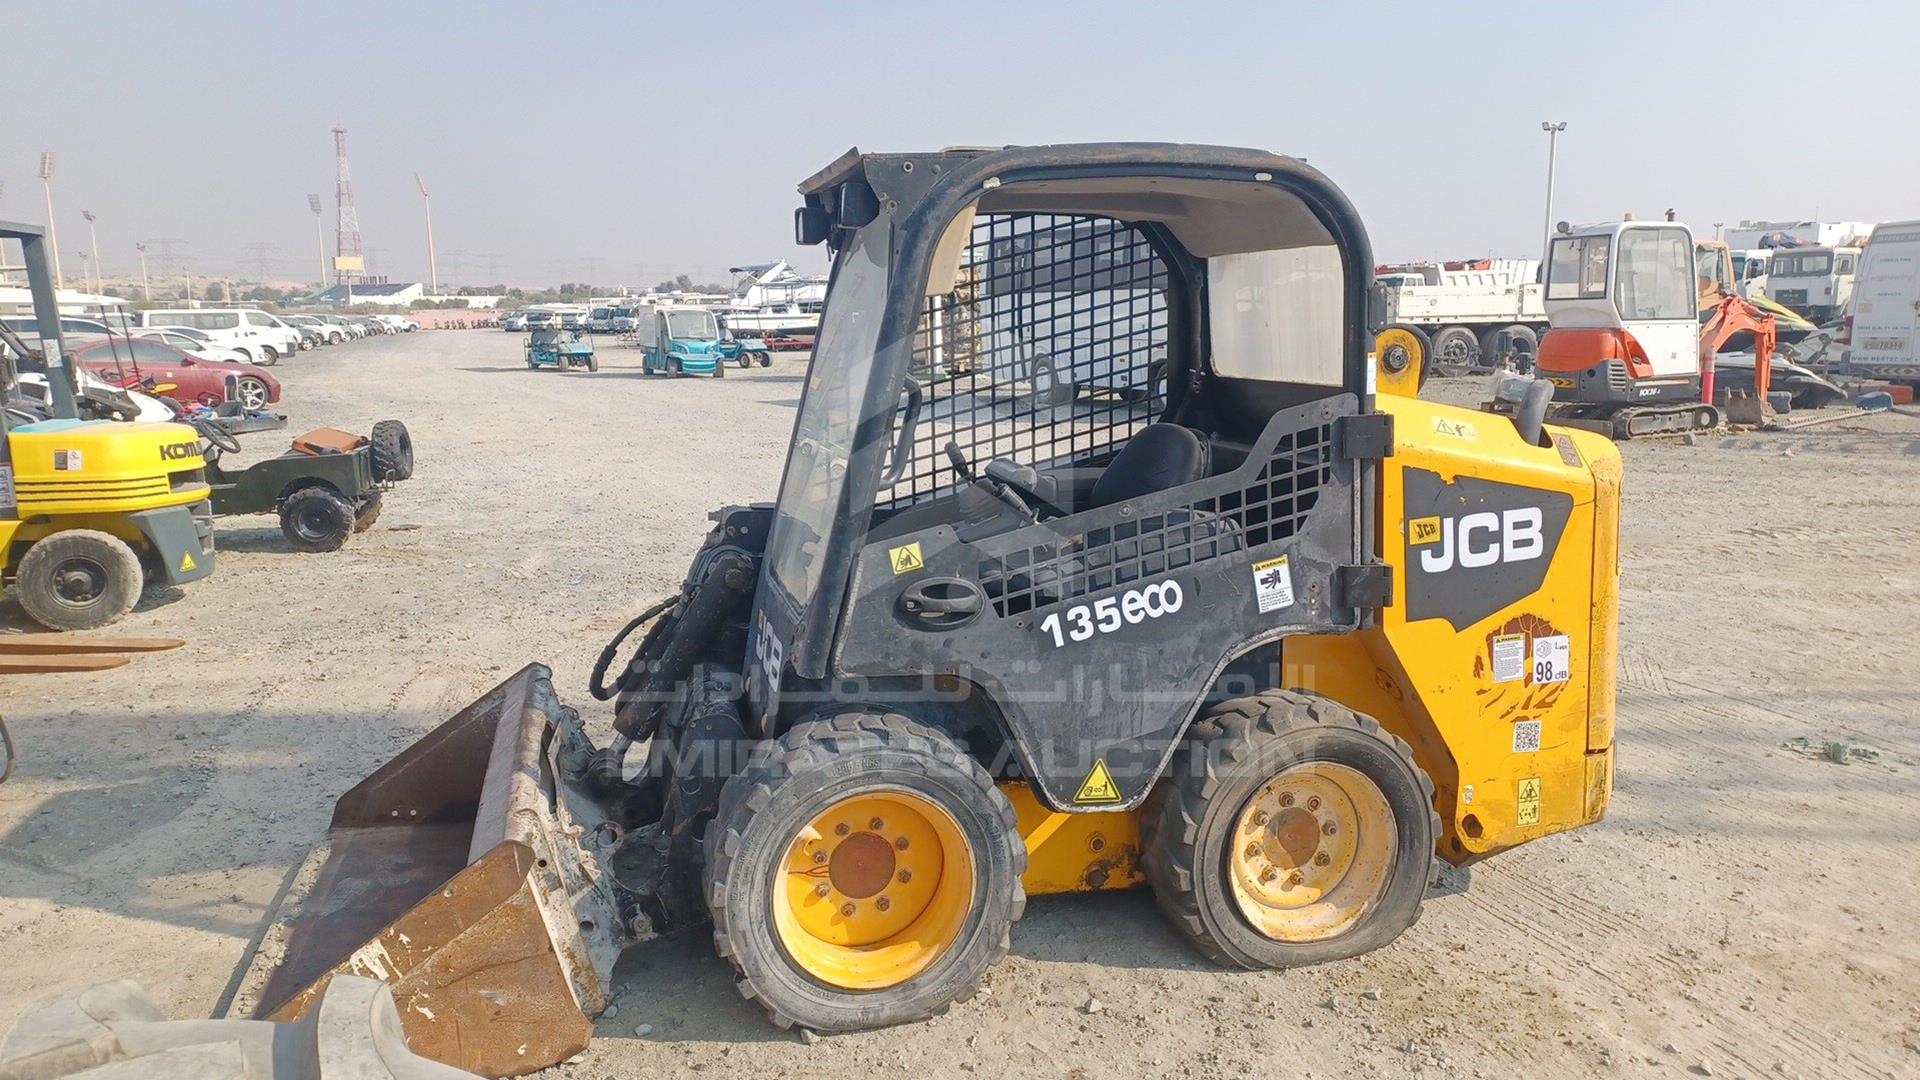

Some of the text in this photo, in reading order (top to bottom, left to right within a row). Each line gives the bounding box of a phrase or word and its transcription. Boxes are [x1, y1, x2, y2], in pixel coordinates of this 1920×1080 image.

[1416, 523, 1437, 539] JCB
[1421, 507, 1544, 573] JCB
[1040, 579, 1184, 648] 135eco
[755, 608, 784, 693] JCB
[1535, 660, 1568, 682] 98 dB
